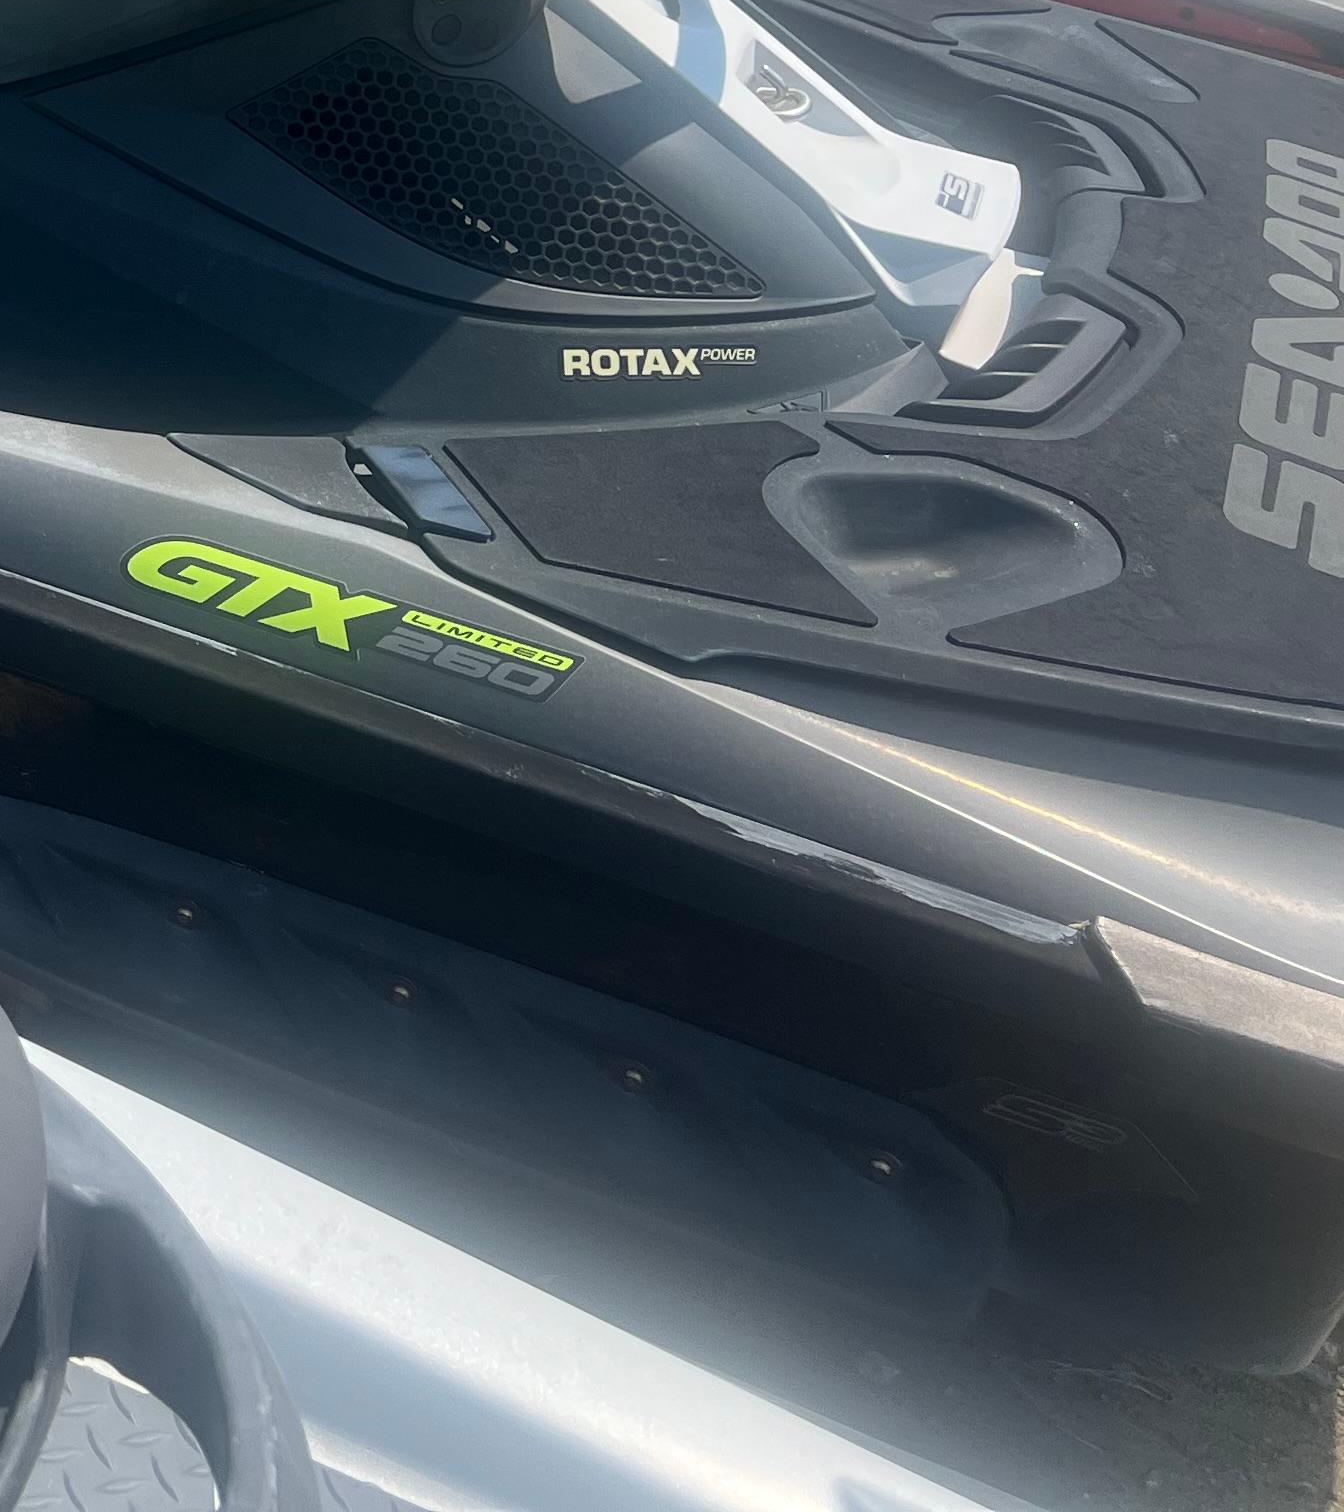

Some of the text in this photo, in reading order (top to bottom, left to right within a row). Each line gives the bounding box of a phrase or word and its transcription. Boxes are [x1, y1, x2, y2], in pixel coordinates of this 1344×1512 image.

[562, 347, 756, 377] ROTAX POWER
[127, 540, 566, 668] GTX LIMITED
[375, 626, 557, 696] 260
